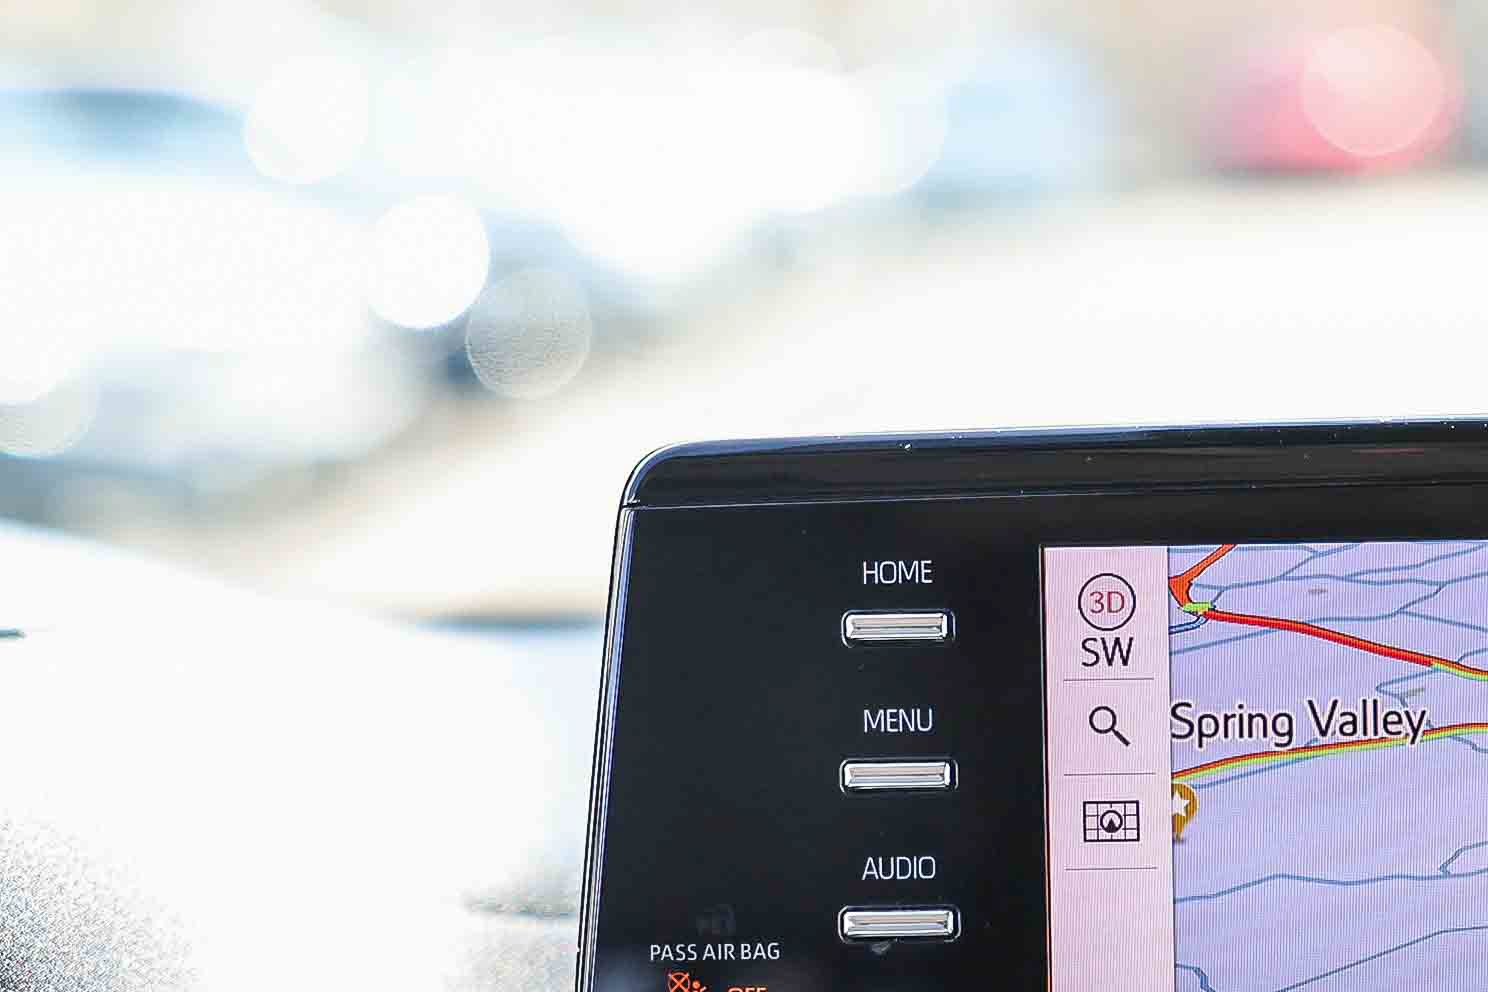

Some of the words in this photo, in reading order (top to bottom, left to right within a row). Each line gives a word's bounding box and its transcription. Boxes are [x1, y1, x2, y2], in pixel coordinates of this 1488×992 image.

[862, 559, 933, 585] HOME
[1089, 590, 1125, 614] 3D
[1081, 636, 1134, 668] SW
[863, 708, 933, 733] MENU
[1169, 701, 1295, 748] Spring
[1307, 698, 1427, 745] Valley
[861, 855, 936, 881] AUDIO
[650, 943, 698, 961] PASS
[702, 943, 736, 961] AIR
[740, 942, 780, 960] BAG
